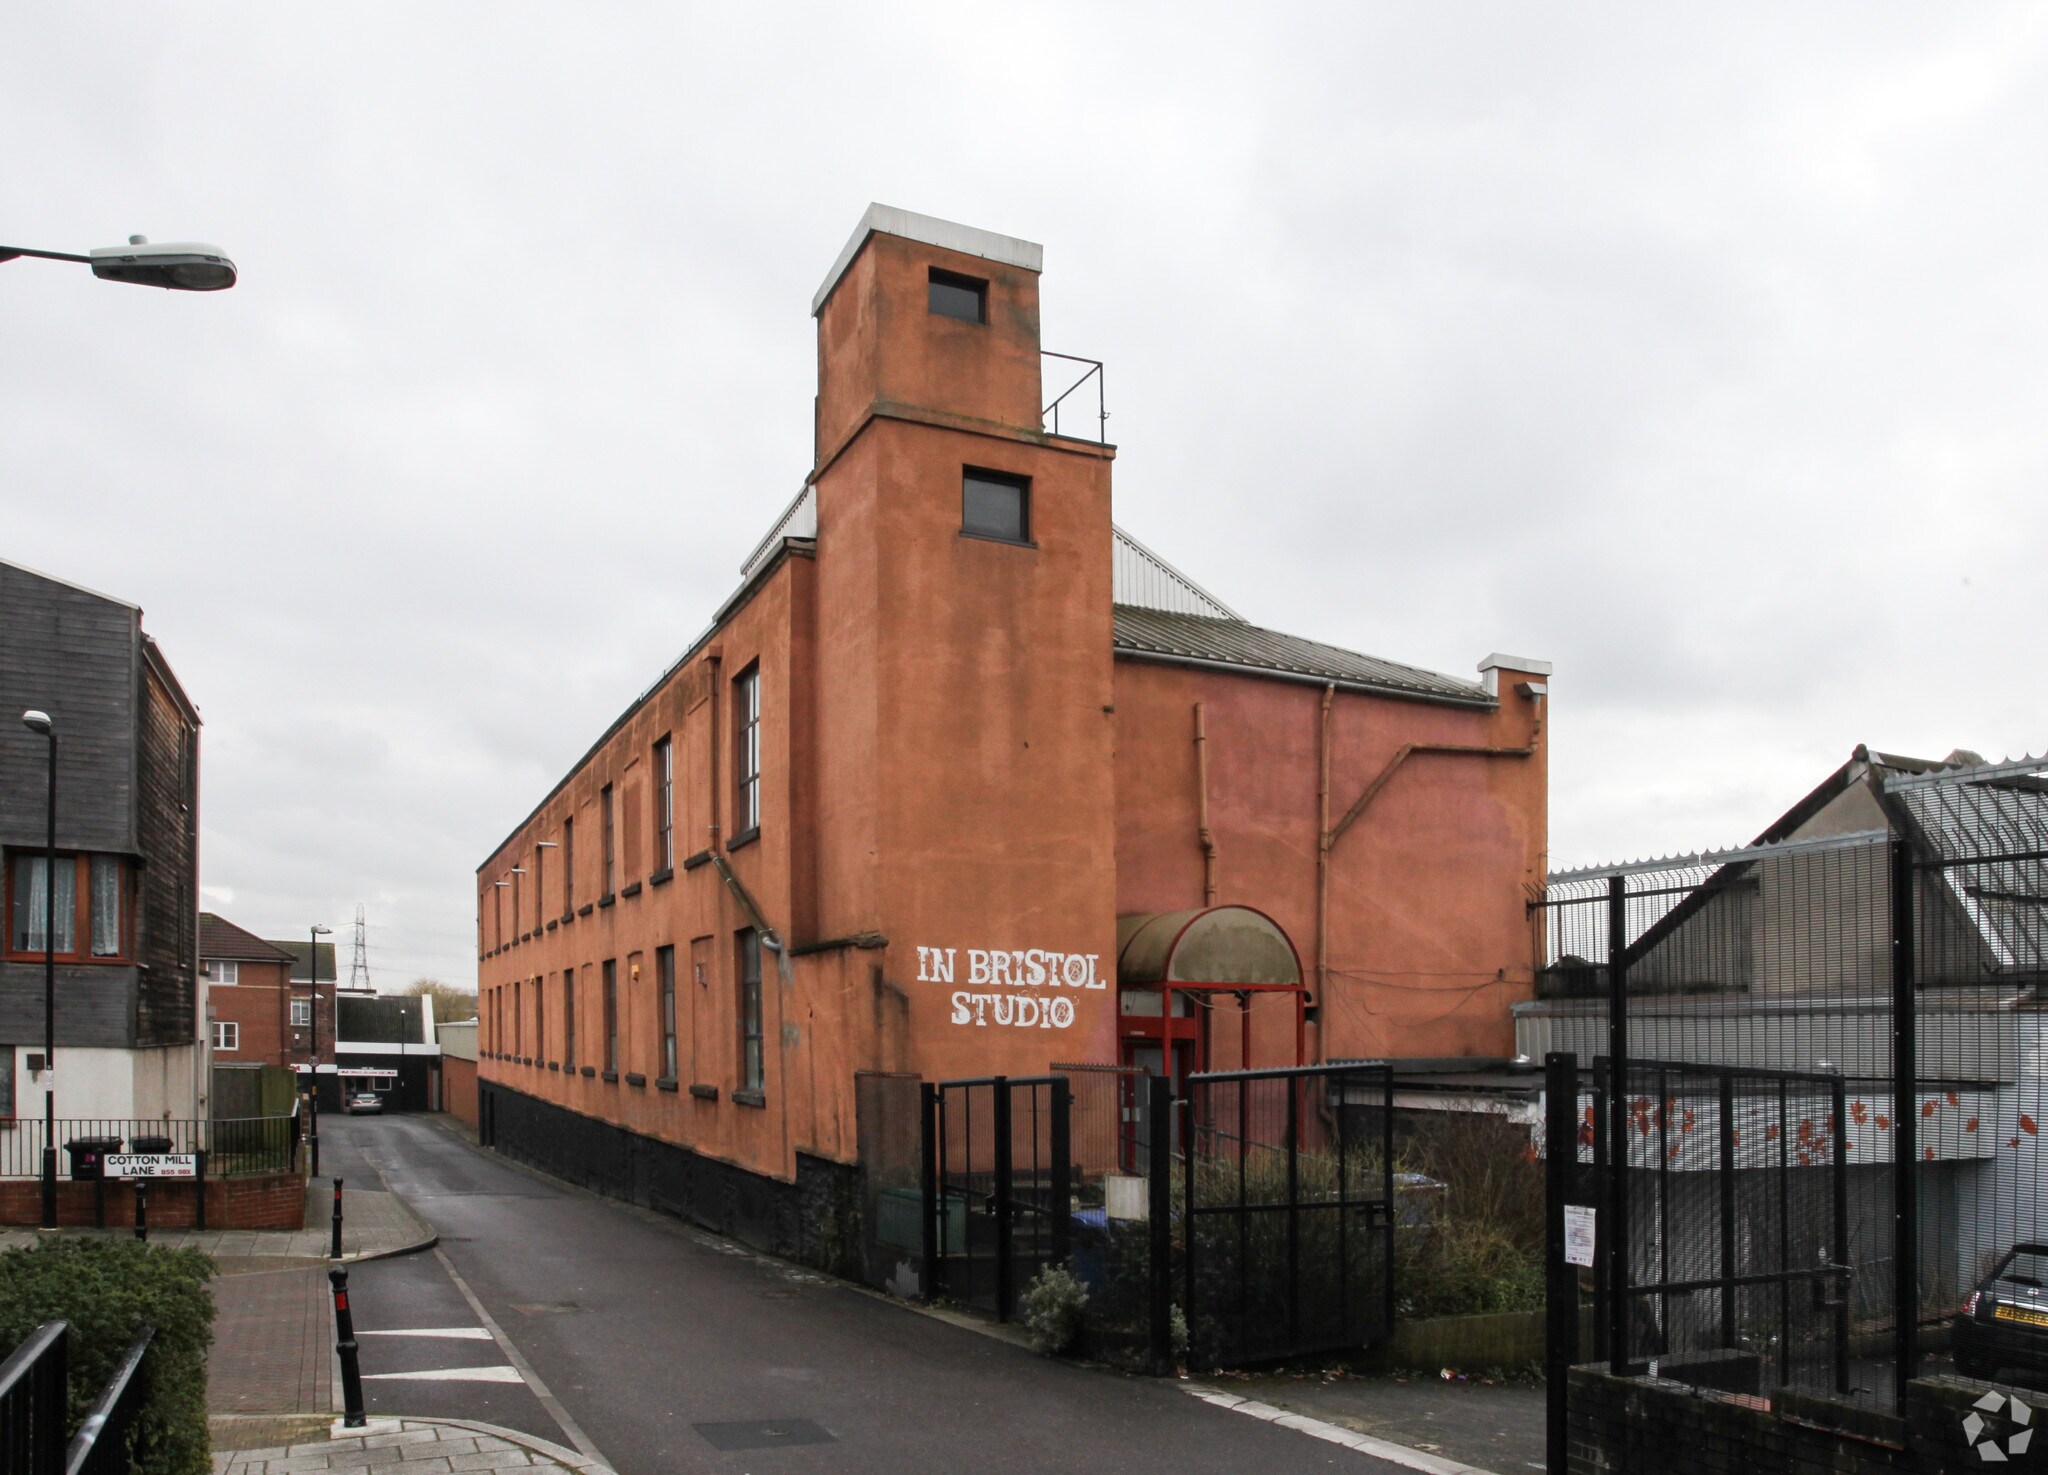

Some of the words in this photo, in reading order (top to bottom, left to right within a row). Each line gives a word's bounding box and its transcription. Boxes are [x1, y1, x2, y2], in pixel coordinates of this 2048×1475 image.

[917, 946, 957, 983] IN
[967, 949, 1107, 990] BRISTOL
[951, 991, 1076, 1029] STUDIO
[107, 1155, 160, 1165] COTTON
[164, 1155, 192, 1165] MILL
[122, 1166, 155, 1175] LANE
